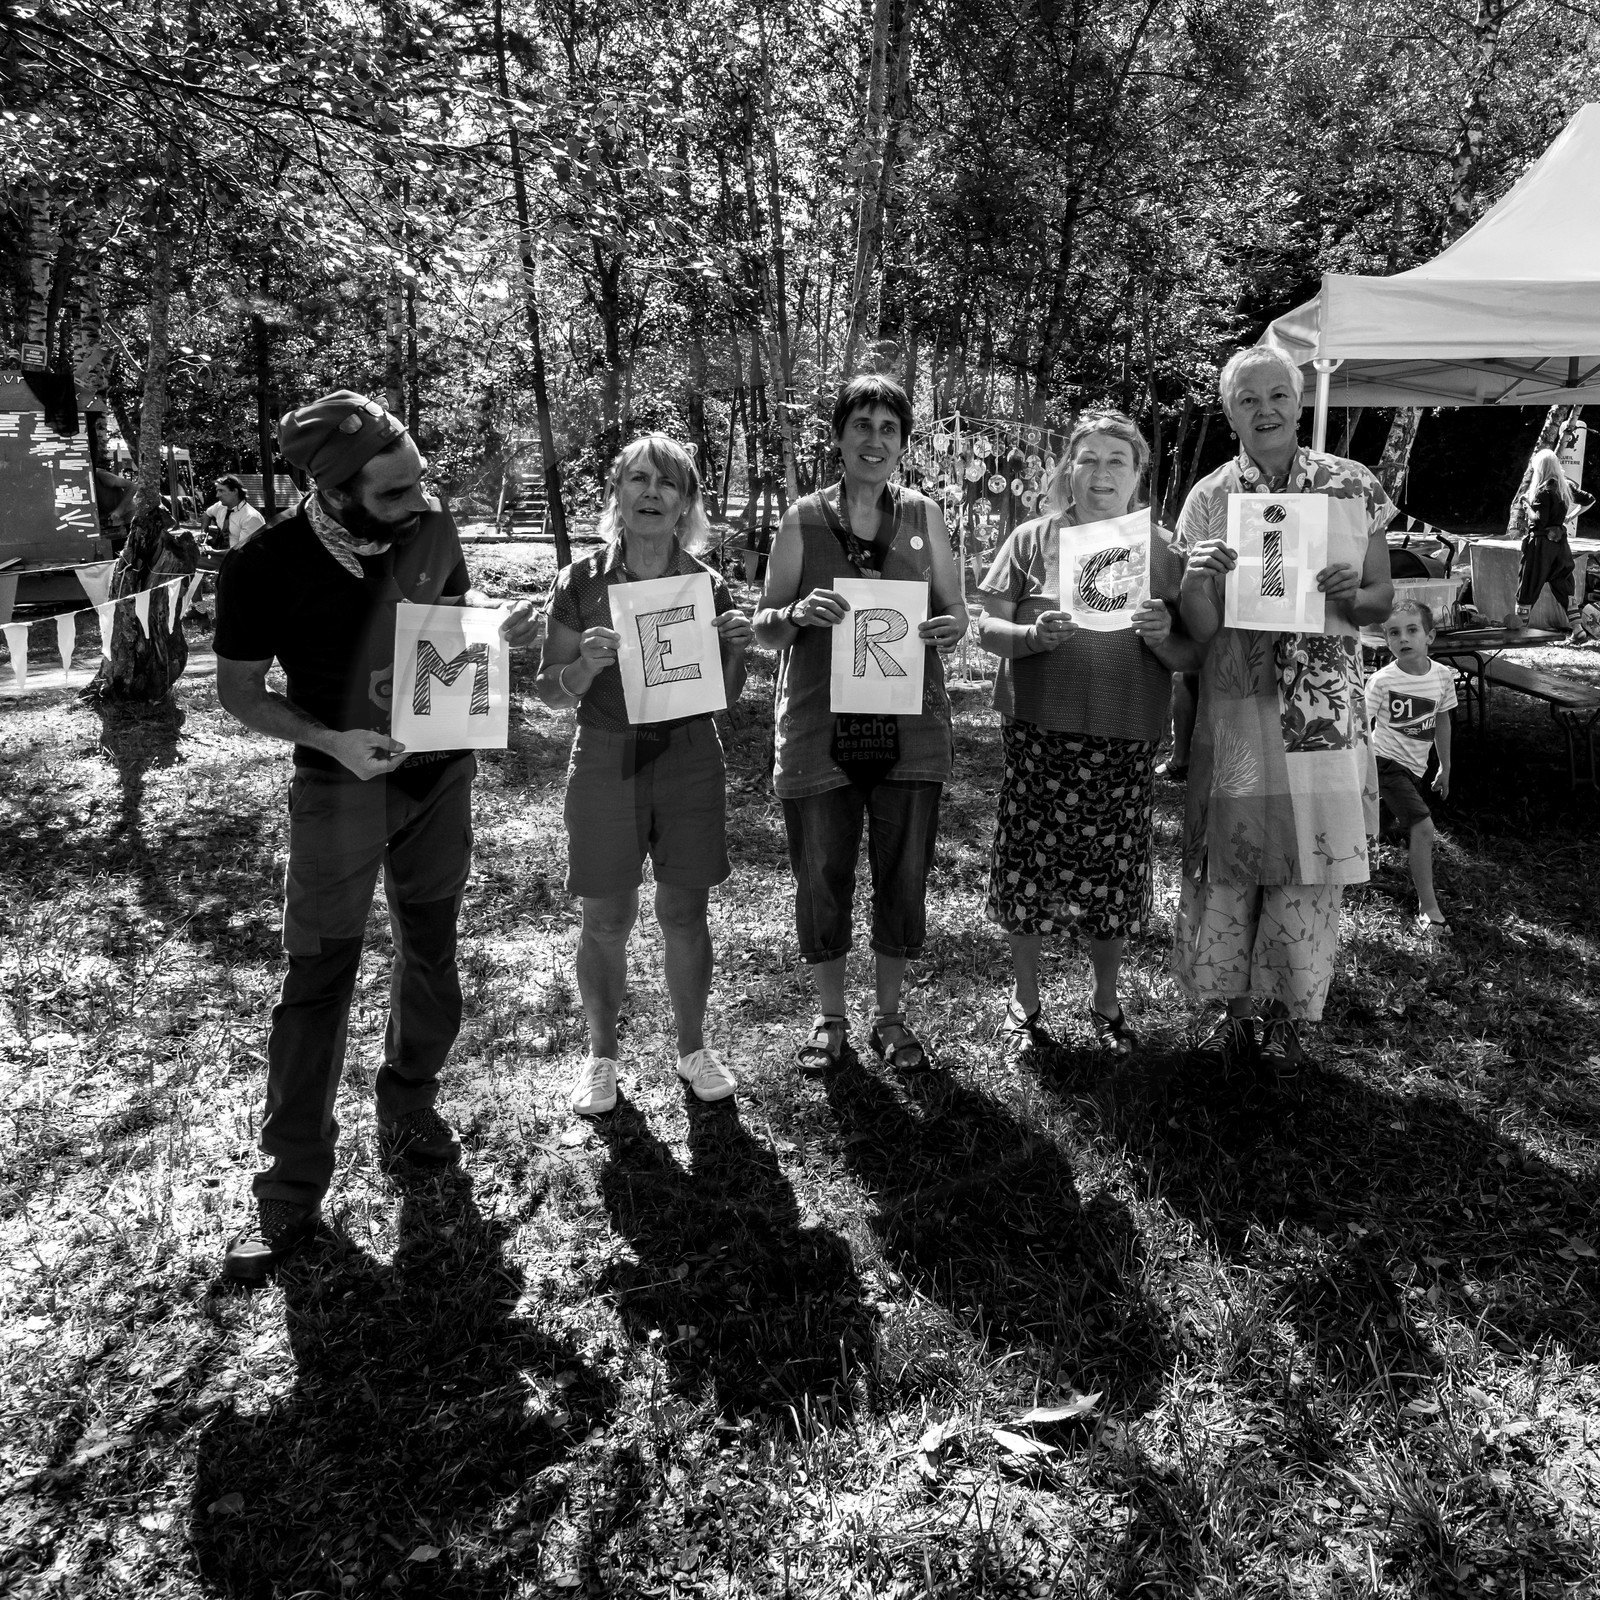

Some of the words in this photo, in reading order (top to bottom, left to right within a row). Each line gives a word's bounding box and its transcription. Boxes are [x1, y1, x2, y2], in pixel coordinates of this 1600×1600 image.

[635, 604, 702, 688] E
[852, 608, 909, 679] R
[412, 639, 490, 716] M
[1391, 698, 1413, 718] 91
[836, 718, 896, 737] L'écho
[837, 738, 858, 749] des
[859, 737, 895, 749] mots
[402, 751, 451, 770] ESTIVAL
[837, 752, 850, 762] LE
[852, 751, 897, 761] FESTIVAL
